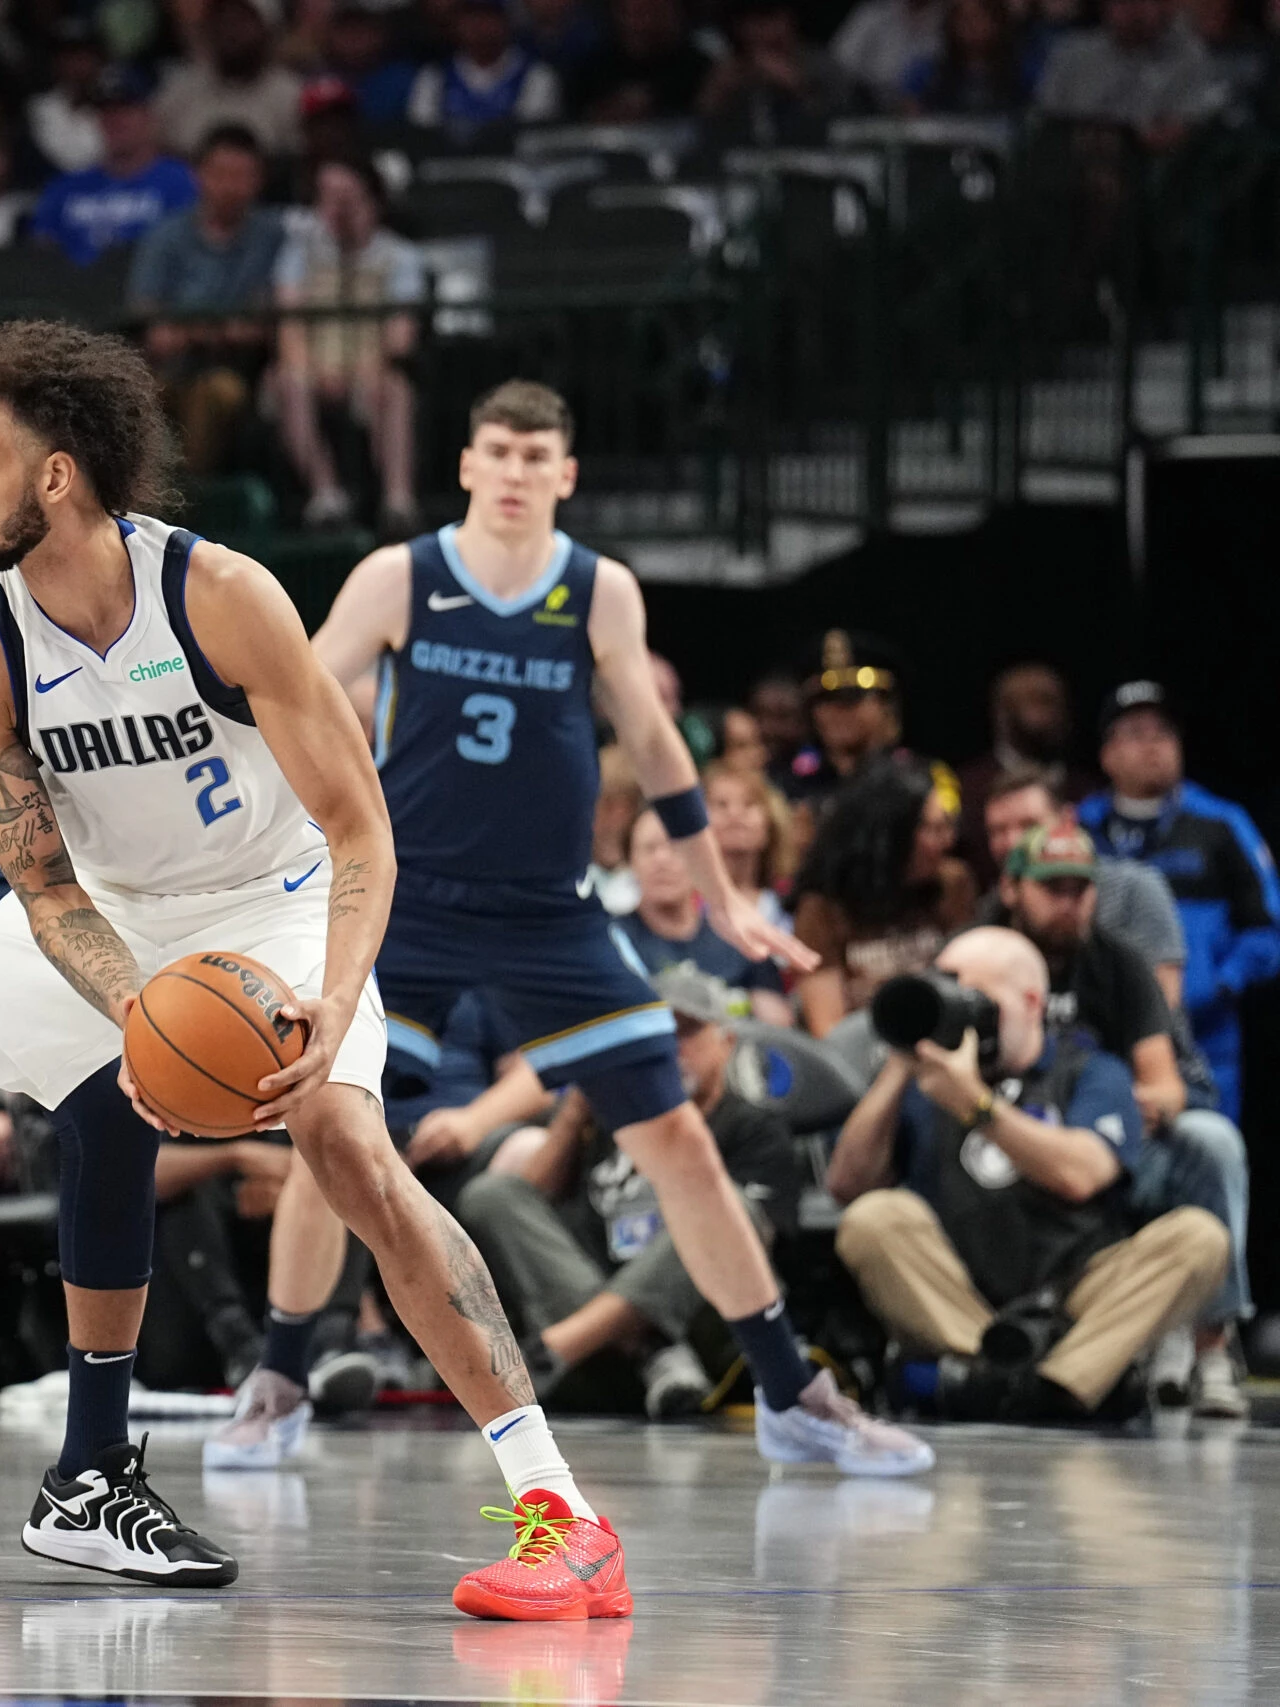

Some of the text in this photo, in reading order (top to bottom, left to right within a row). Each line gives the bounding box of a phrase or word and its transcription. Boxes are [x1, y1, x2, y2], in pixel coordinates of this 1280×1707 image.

[129, 655, 185, 682] chime
[410, 639, 575, 691] GRIZZLIES
[37, 702, 214, 773] DALLAS
[456, 693, 517, 764] 3
[185, 755, 244, 828] 2
